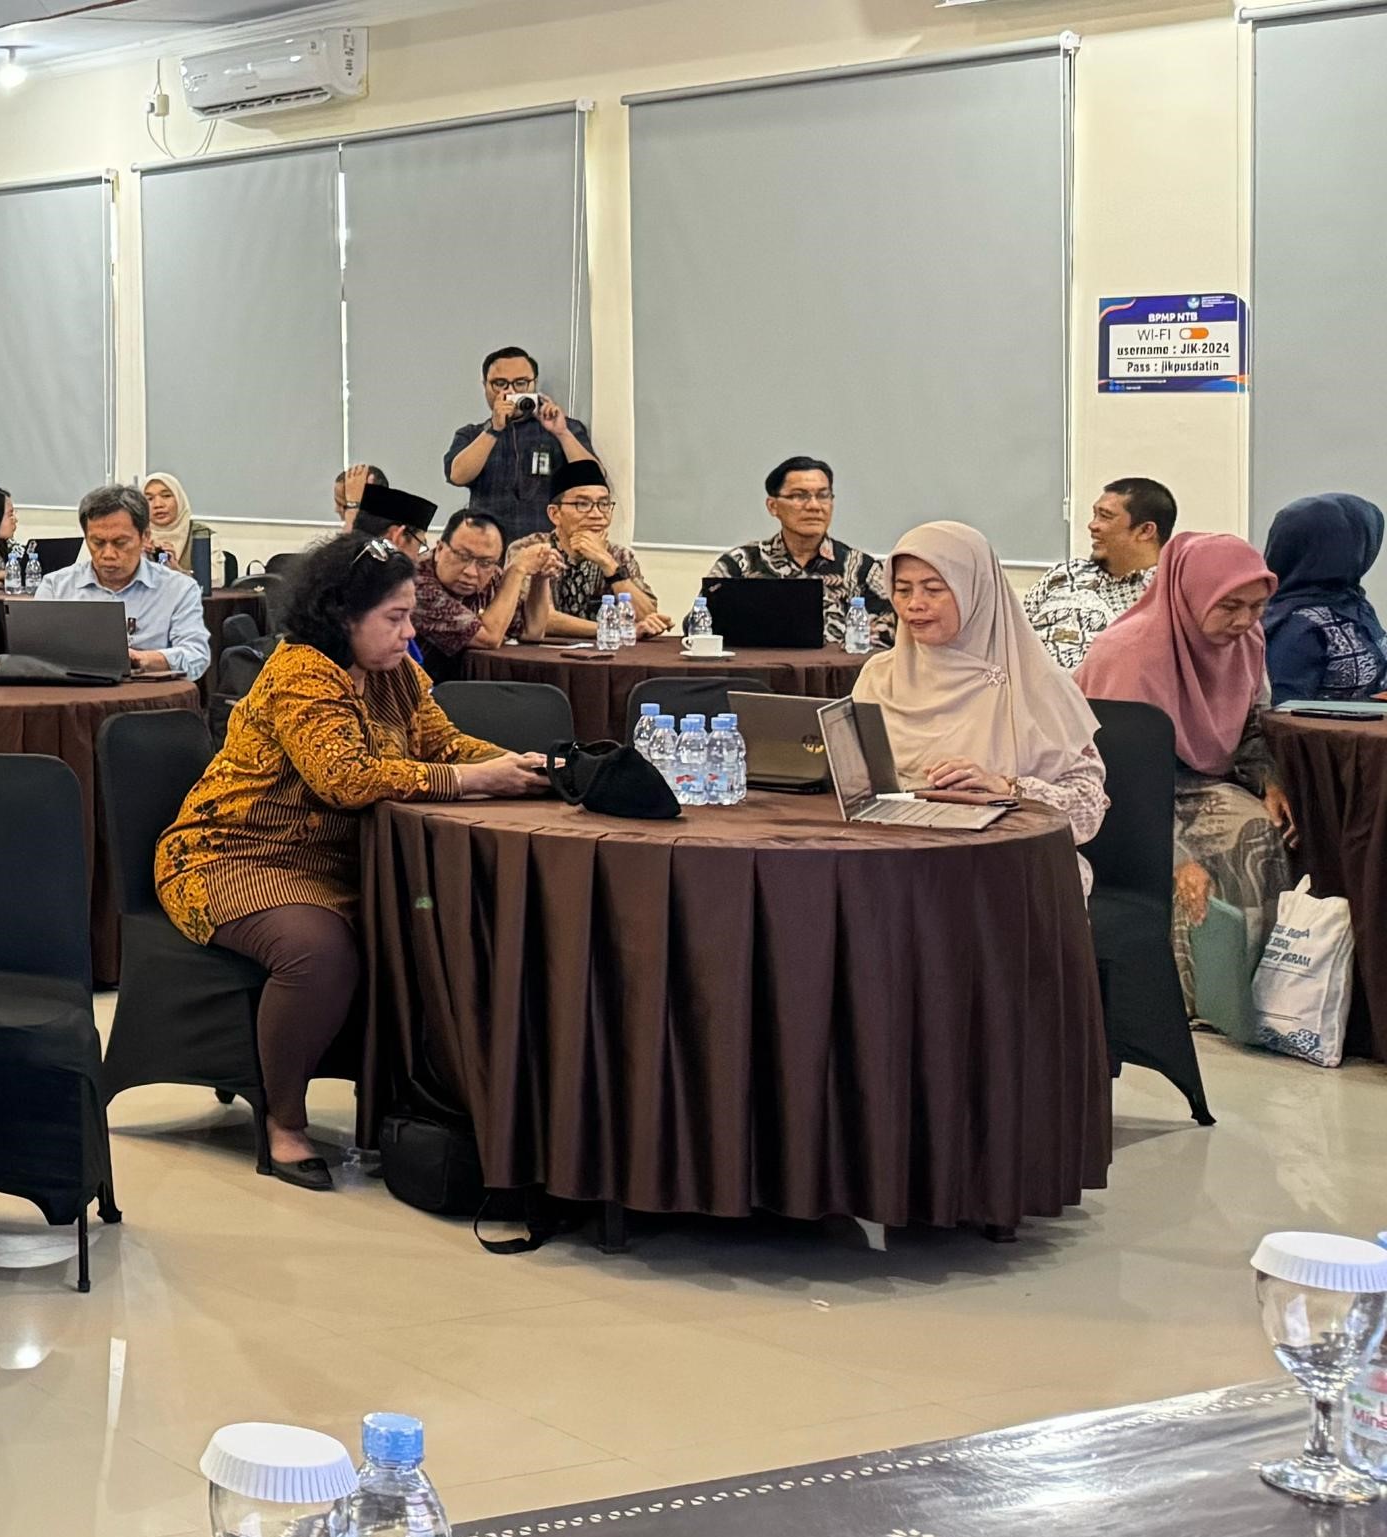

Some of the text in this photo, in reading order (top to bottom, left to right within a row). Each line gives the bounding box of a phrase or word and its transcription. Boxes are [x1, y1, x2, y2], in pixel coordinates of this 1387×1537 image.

[1148, 312, 1198, 323] BPMP NTB
[1137, 328, 1171, 341] WI-FI
[1117, 345, 1169, 356] username
[1127, 361, 1151, 373] Pass
[1161, 360, 1219, 374] jikpusdatin
